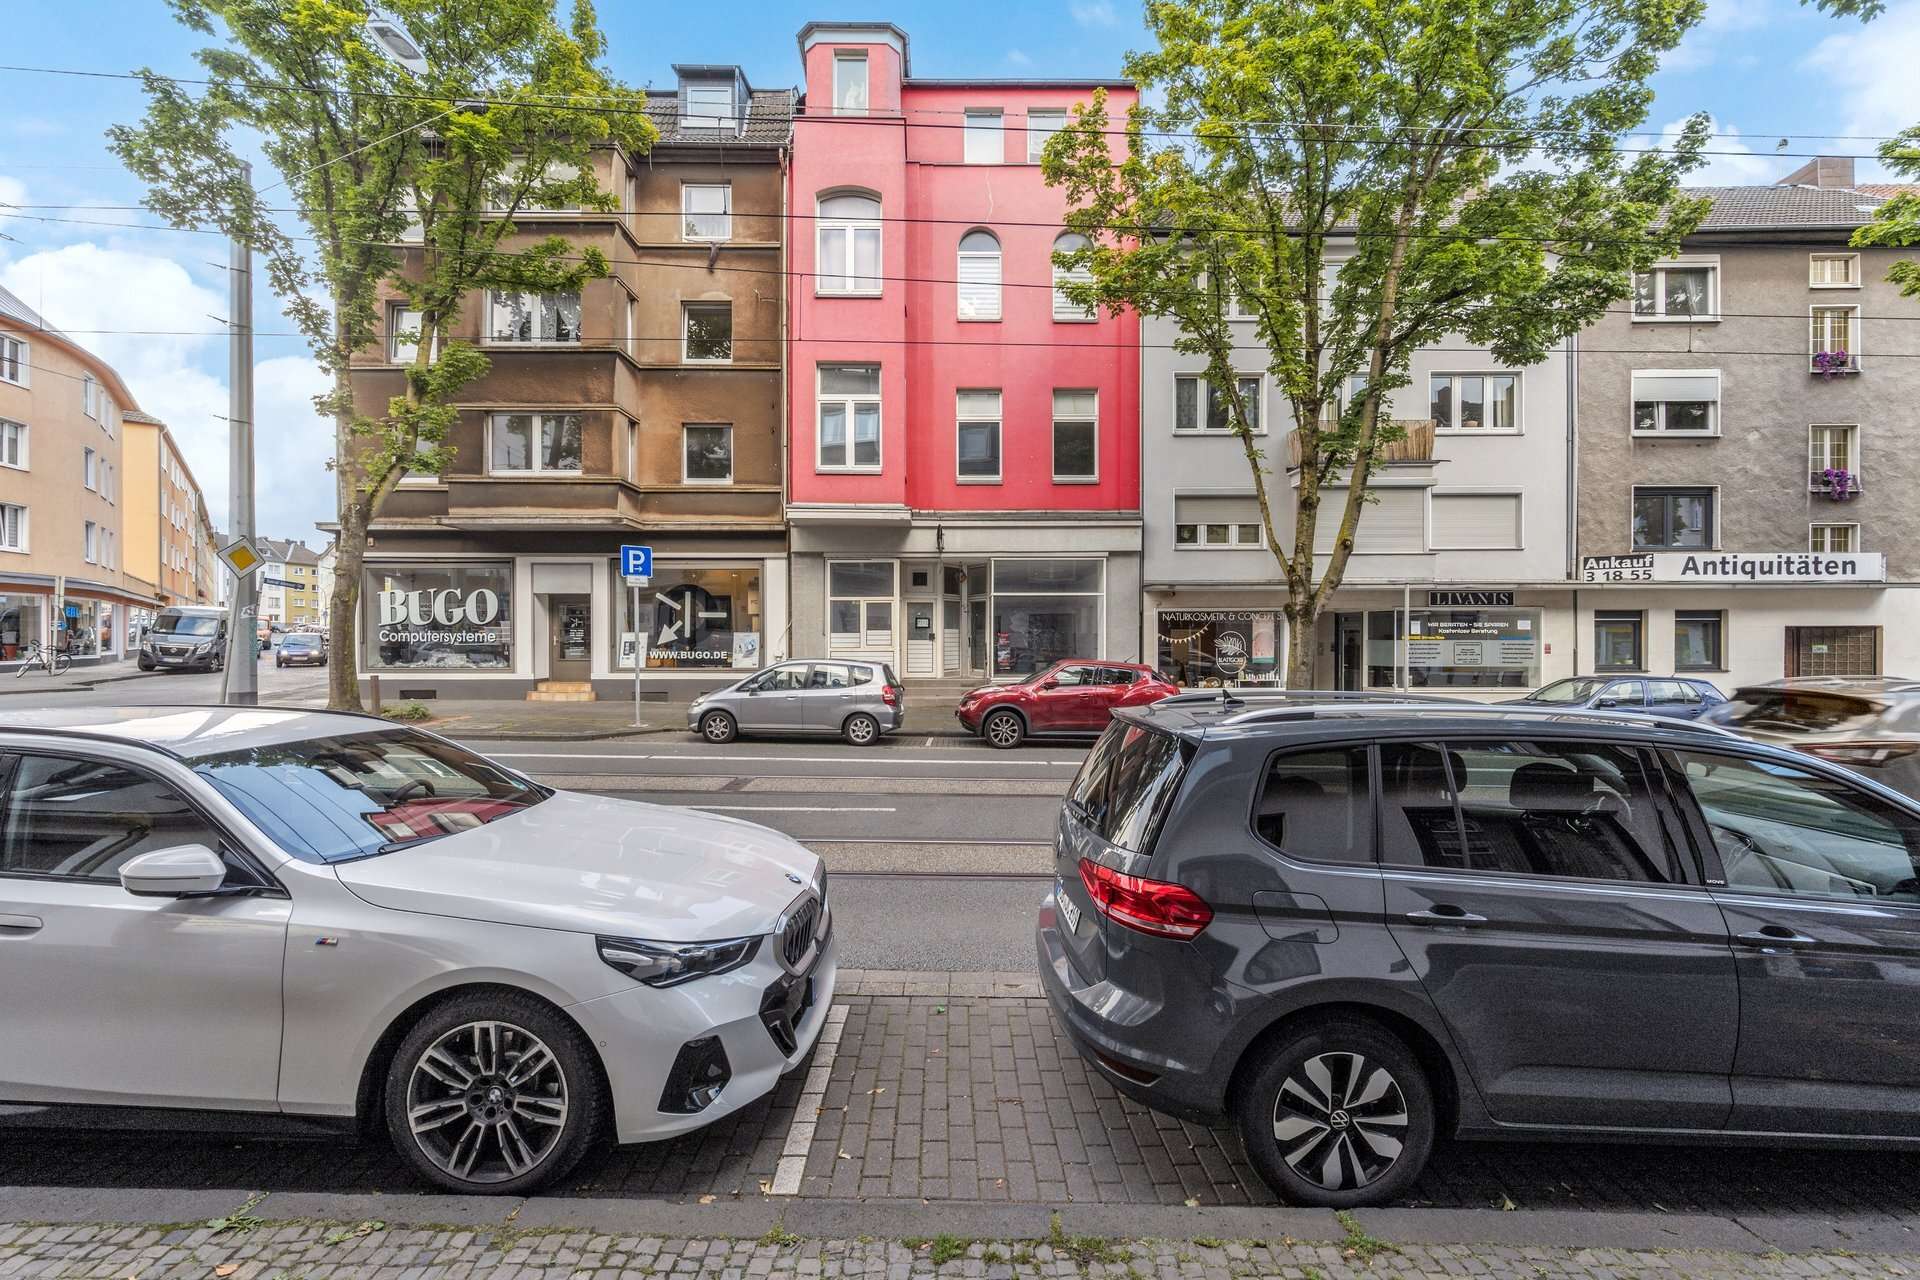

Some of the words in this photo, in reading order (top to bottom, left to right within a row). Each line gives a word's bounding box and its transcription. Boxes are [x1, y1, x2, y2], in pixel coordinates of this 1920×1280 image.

[629, 550, 645, 573] P
[1585, 554, 1653, 570] Ankauf
[1681, 555, 1857, 580] Antiquitäten
[1586, 571, 1594, 582] 3
[1603, 570, 1623, 581] 18
[1631, 569, 1652, 581] 55
[1436, 591, 1510, 605] LIVANIS
[376, 588, 498, 627] BUGO
[1162, 612, 1226, 622] NATURKOSMETIK
[1229, 613, 1237, 621] &
[379, 630, 496, 645] Computersysteme
[650, 651, 728, 660] WWW.BUGO.DE
